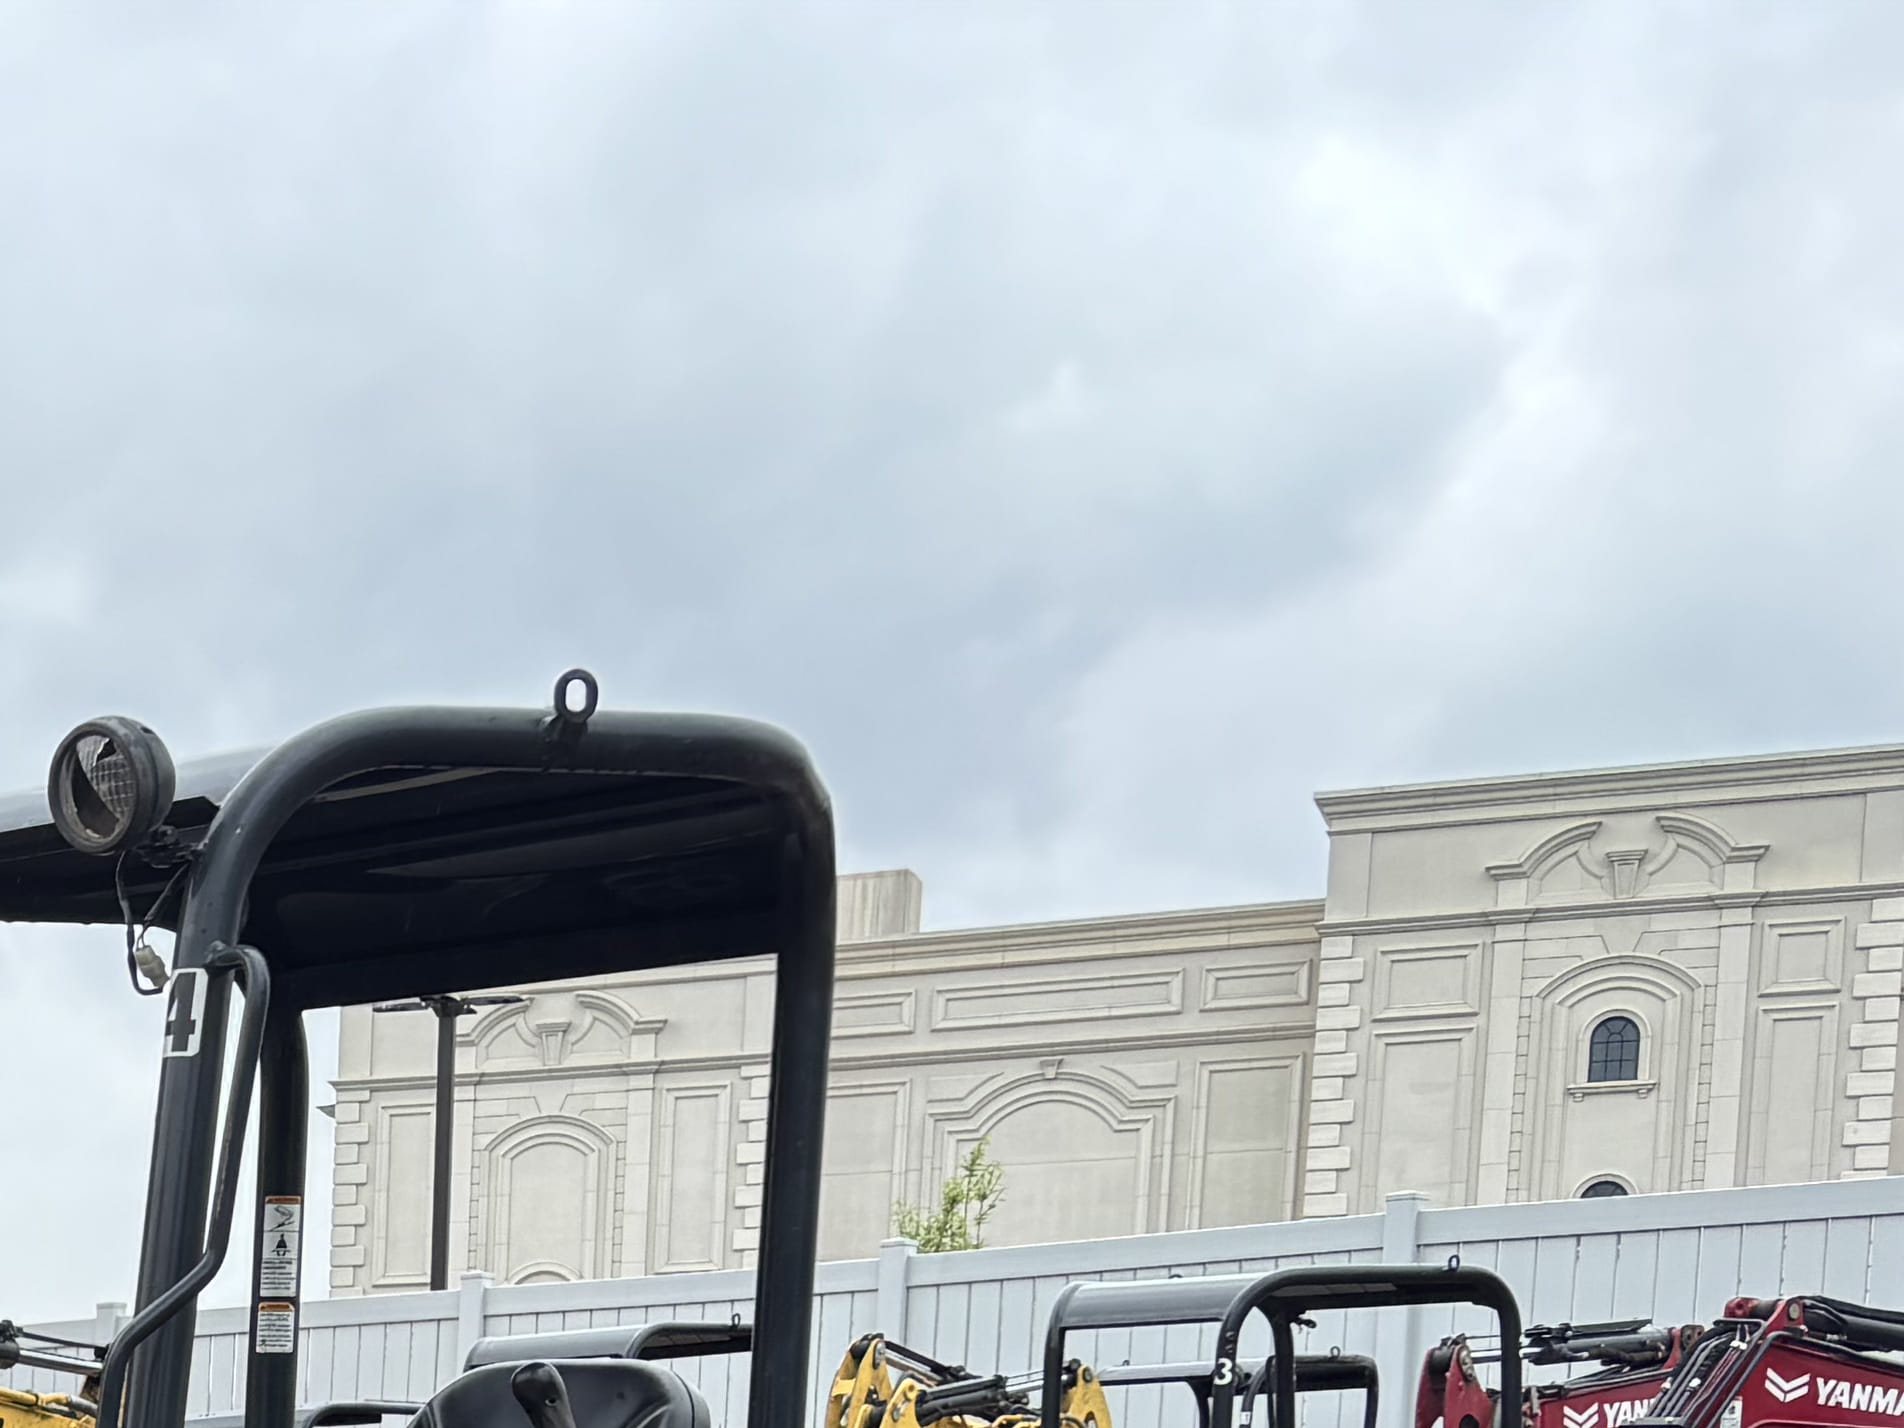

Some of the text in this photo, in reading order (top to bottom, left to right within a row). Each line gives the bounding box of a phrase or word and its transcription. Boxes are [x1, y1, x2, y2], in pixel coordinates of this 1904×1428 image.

[165, 971, 197, 1053] 4
[1213, 1357, 1233, 1386] 3
[1816, 1377, 1904, 1416] YANM
